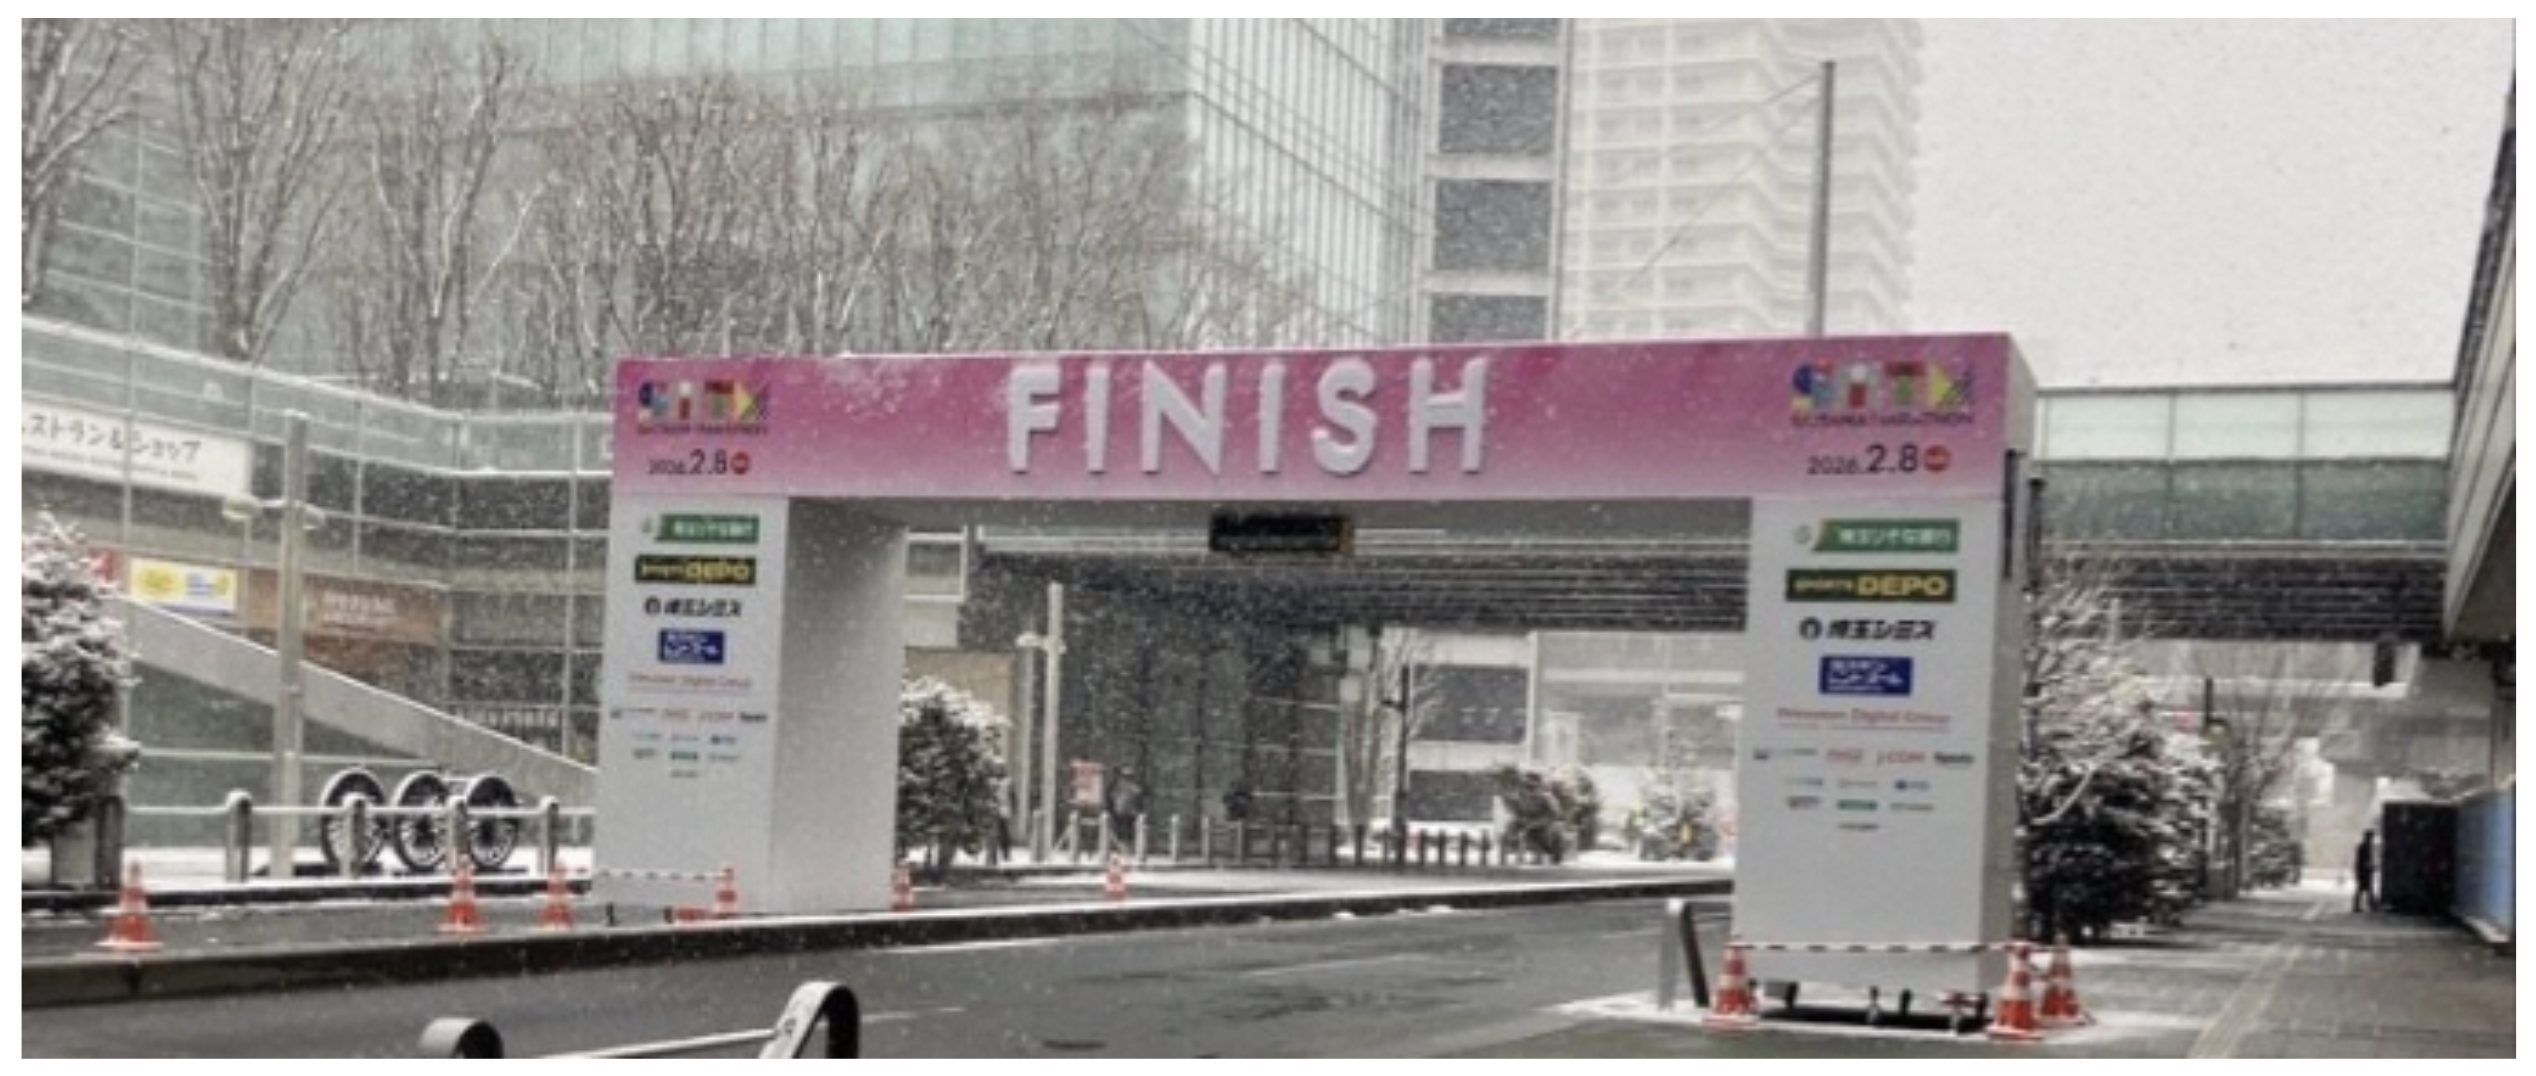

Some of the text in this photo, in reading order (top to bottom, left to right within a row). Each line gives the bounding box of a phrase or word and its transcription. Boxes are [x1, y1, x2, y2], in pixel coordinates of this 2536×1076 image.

[22, 412, 202, 463] ストラン&ショップ
[1008, 357, 1488, 476] FINISH
[1857, 575, 1948, 597] DEPO
